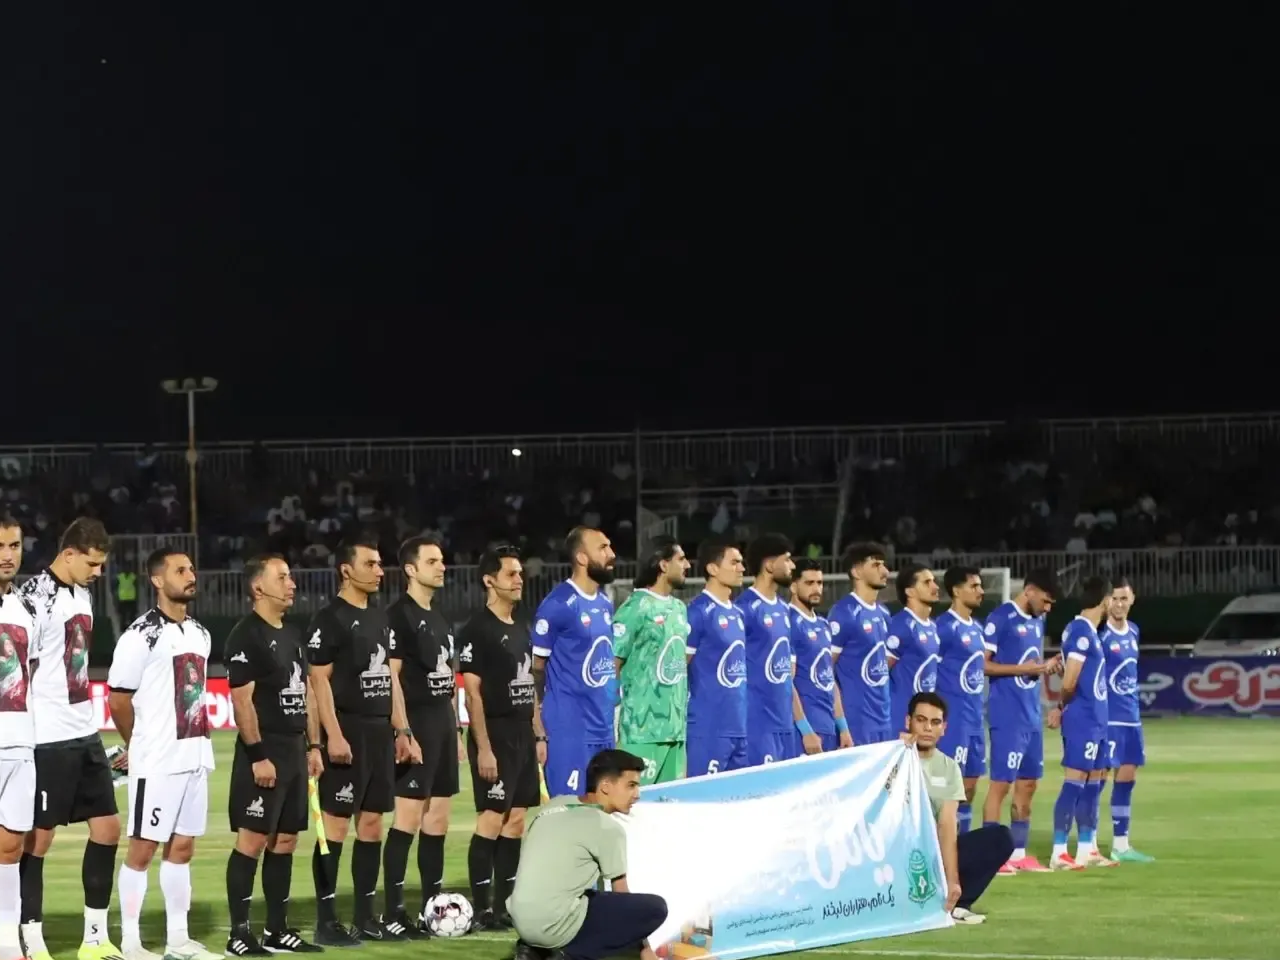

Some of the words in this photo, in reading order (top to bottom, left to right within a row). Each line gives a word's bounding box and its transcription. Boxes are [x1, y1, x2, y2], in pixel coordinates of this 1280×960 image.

[282, 694, 306, 706] ارس
[1007, 751, 1024, 770] 87
[567, 770, 580, 791] 4
[40, 790, 48, 812] 1
[822, 903, 843, 920] لبخند
